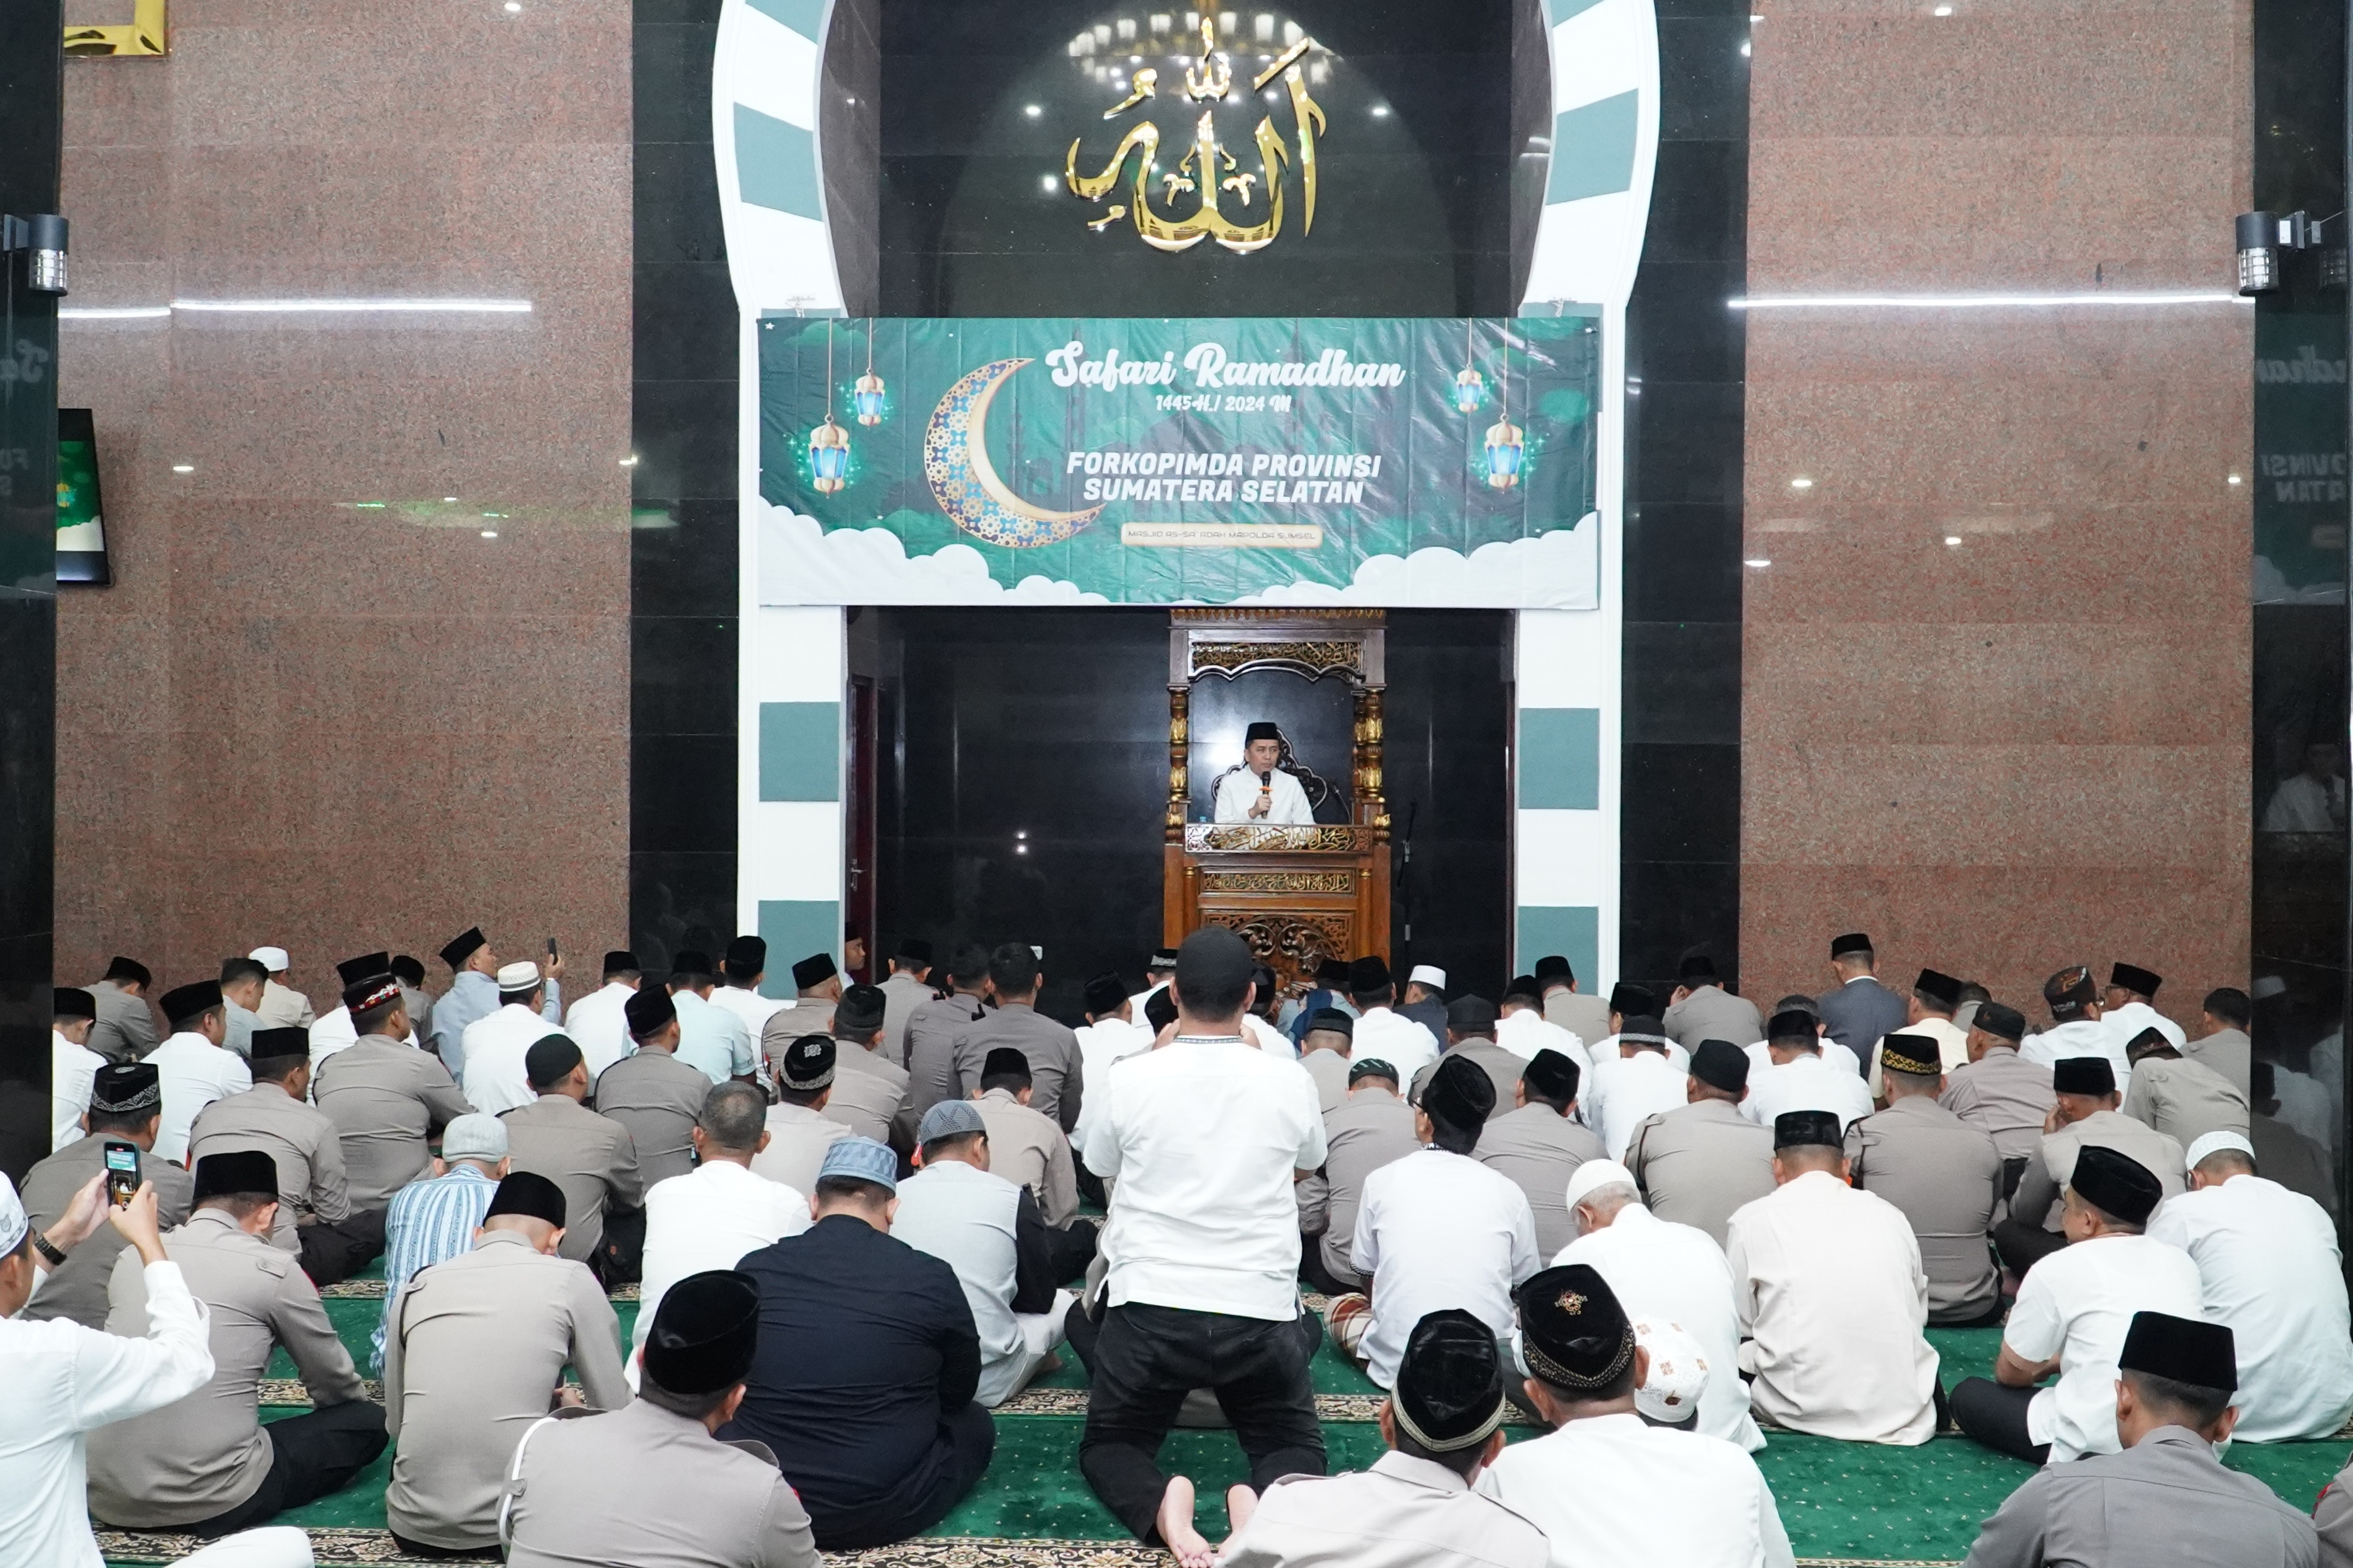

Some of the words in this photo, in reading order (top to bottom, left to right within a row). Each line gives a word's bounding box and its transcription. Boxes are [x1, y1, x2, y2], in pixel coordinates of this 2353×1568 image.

[1045, 340, 1177, 392] Safari
[1184, 342, 1407, 388] Ramadhan
[1224, 396, 1265, 412] 2024
[1269, 394, 1292, 412] M
[1067, 451, 1243, 476] FORKOPIMDA
[1251, 454, 1382, 477] PROVINSI
[1083, 478, 1232, 502] SUMATERA
[1241, 480, 1364, 503] SELATAN
[1277, 532, 1316, 540] SUMSEL
